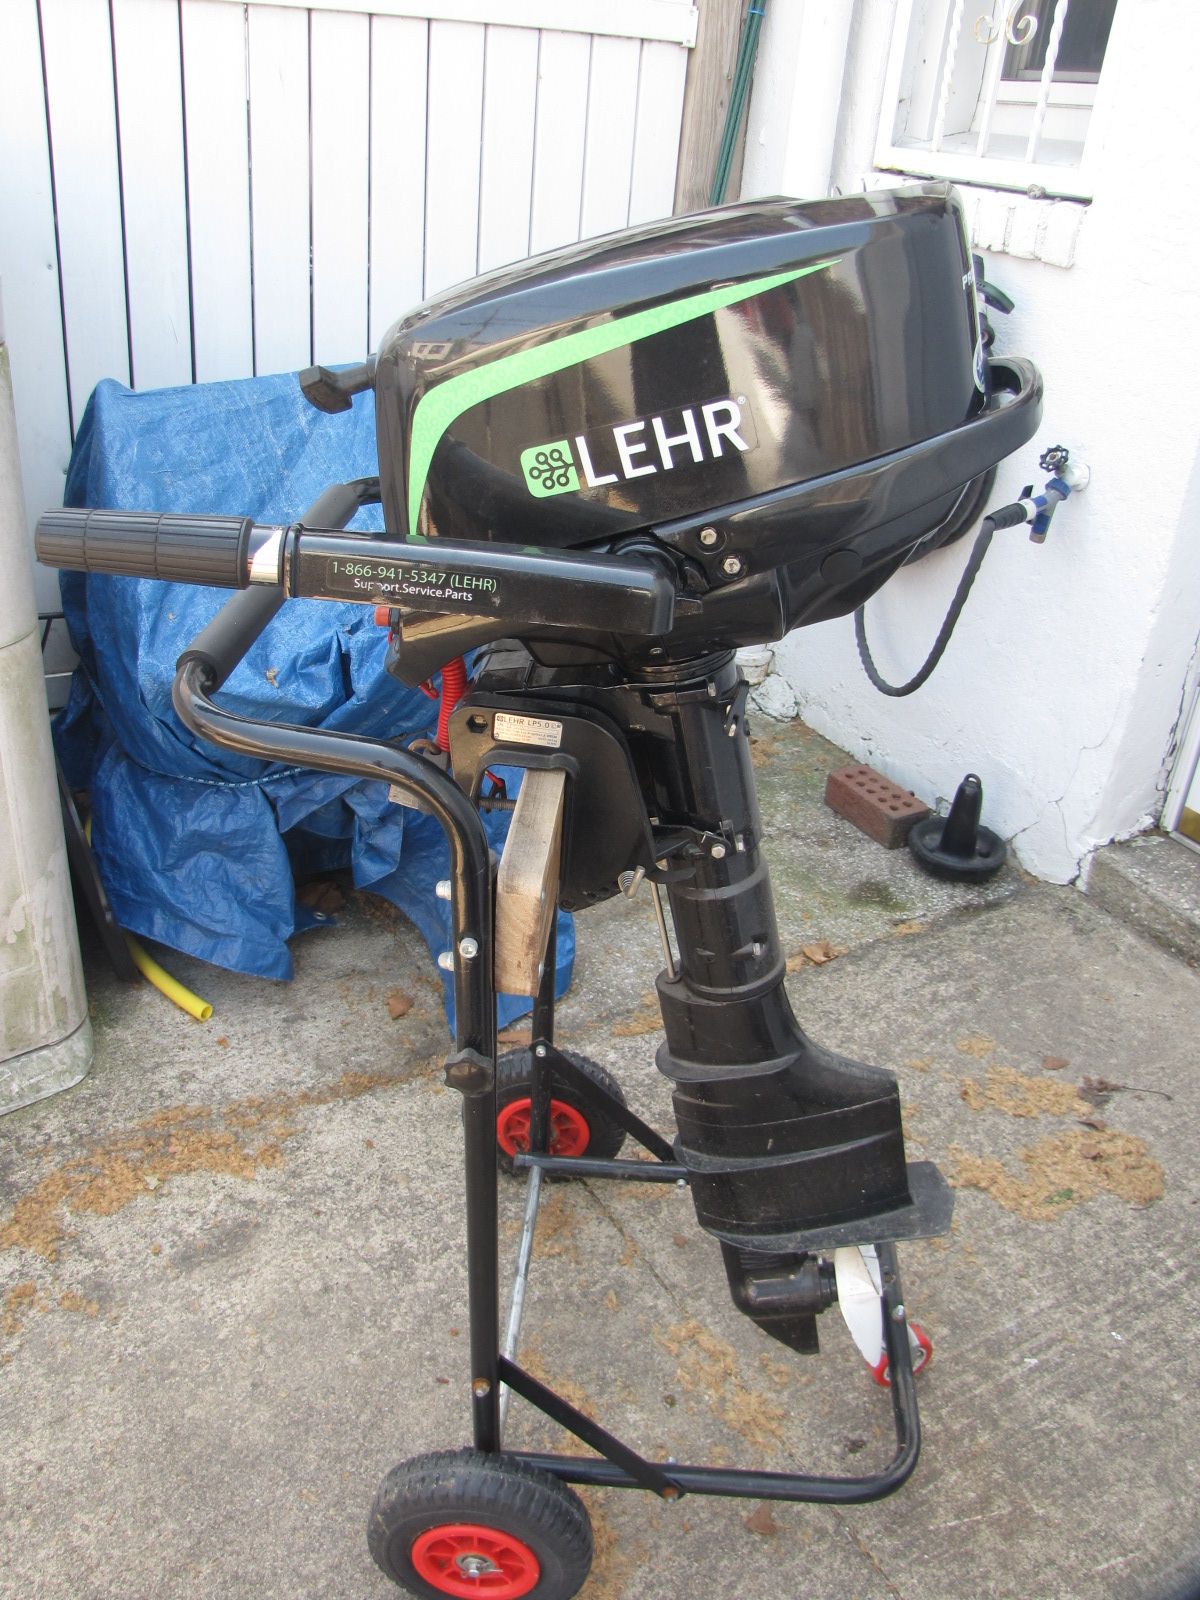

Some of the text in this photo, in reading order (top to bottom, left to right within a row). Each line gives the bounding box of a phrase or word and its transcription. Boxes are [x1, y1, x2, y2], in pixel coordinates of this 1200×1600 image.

[575, 399, 750, 488] LEHR
[332, 561, 497, 593] 1-866-941-5347 (LEHR)
[503, 716, 525, 725] LEHR
